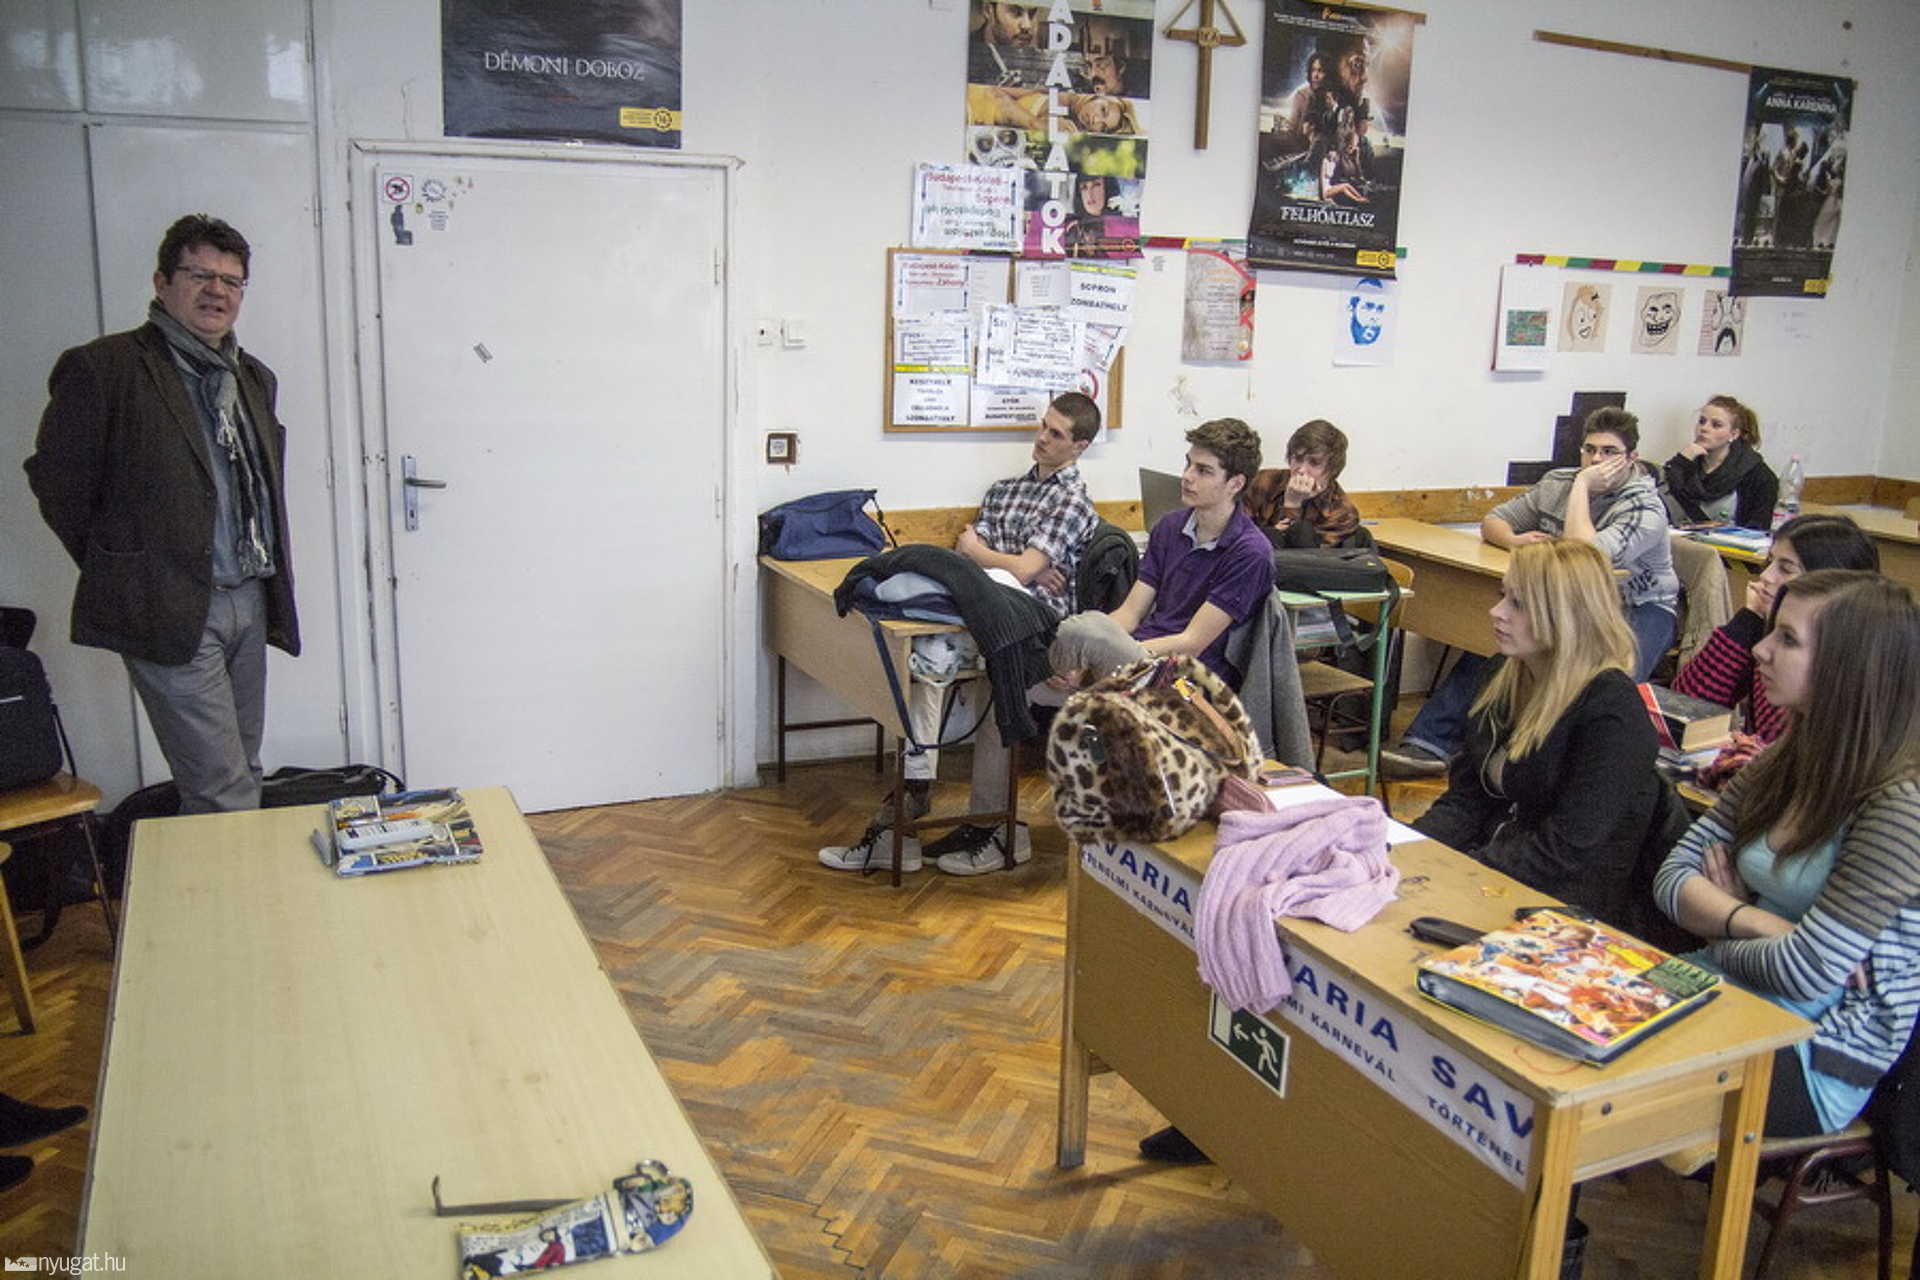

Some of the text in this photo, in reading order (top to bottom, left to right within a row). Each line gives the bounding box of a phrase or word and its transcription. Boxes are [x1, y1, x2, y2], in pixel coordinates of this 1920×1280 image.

[484, 50, 645, 81] DÉMONI DOBOZ
[1311, 1011, 1396, 1083] KARNEVÁL
[1431, 1055, 1535, 1138] SAV
